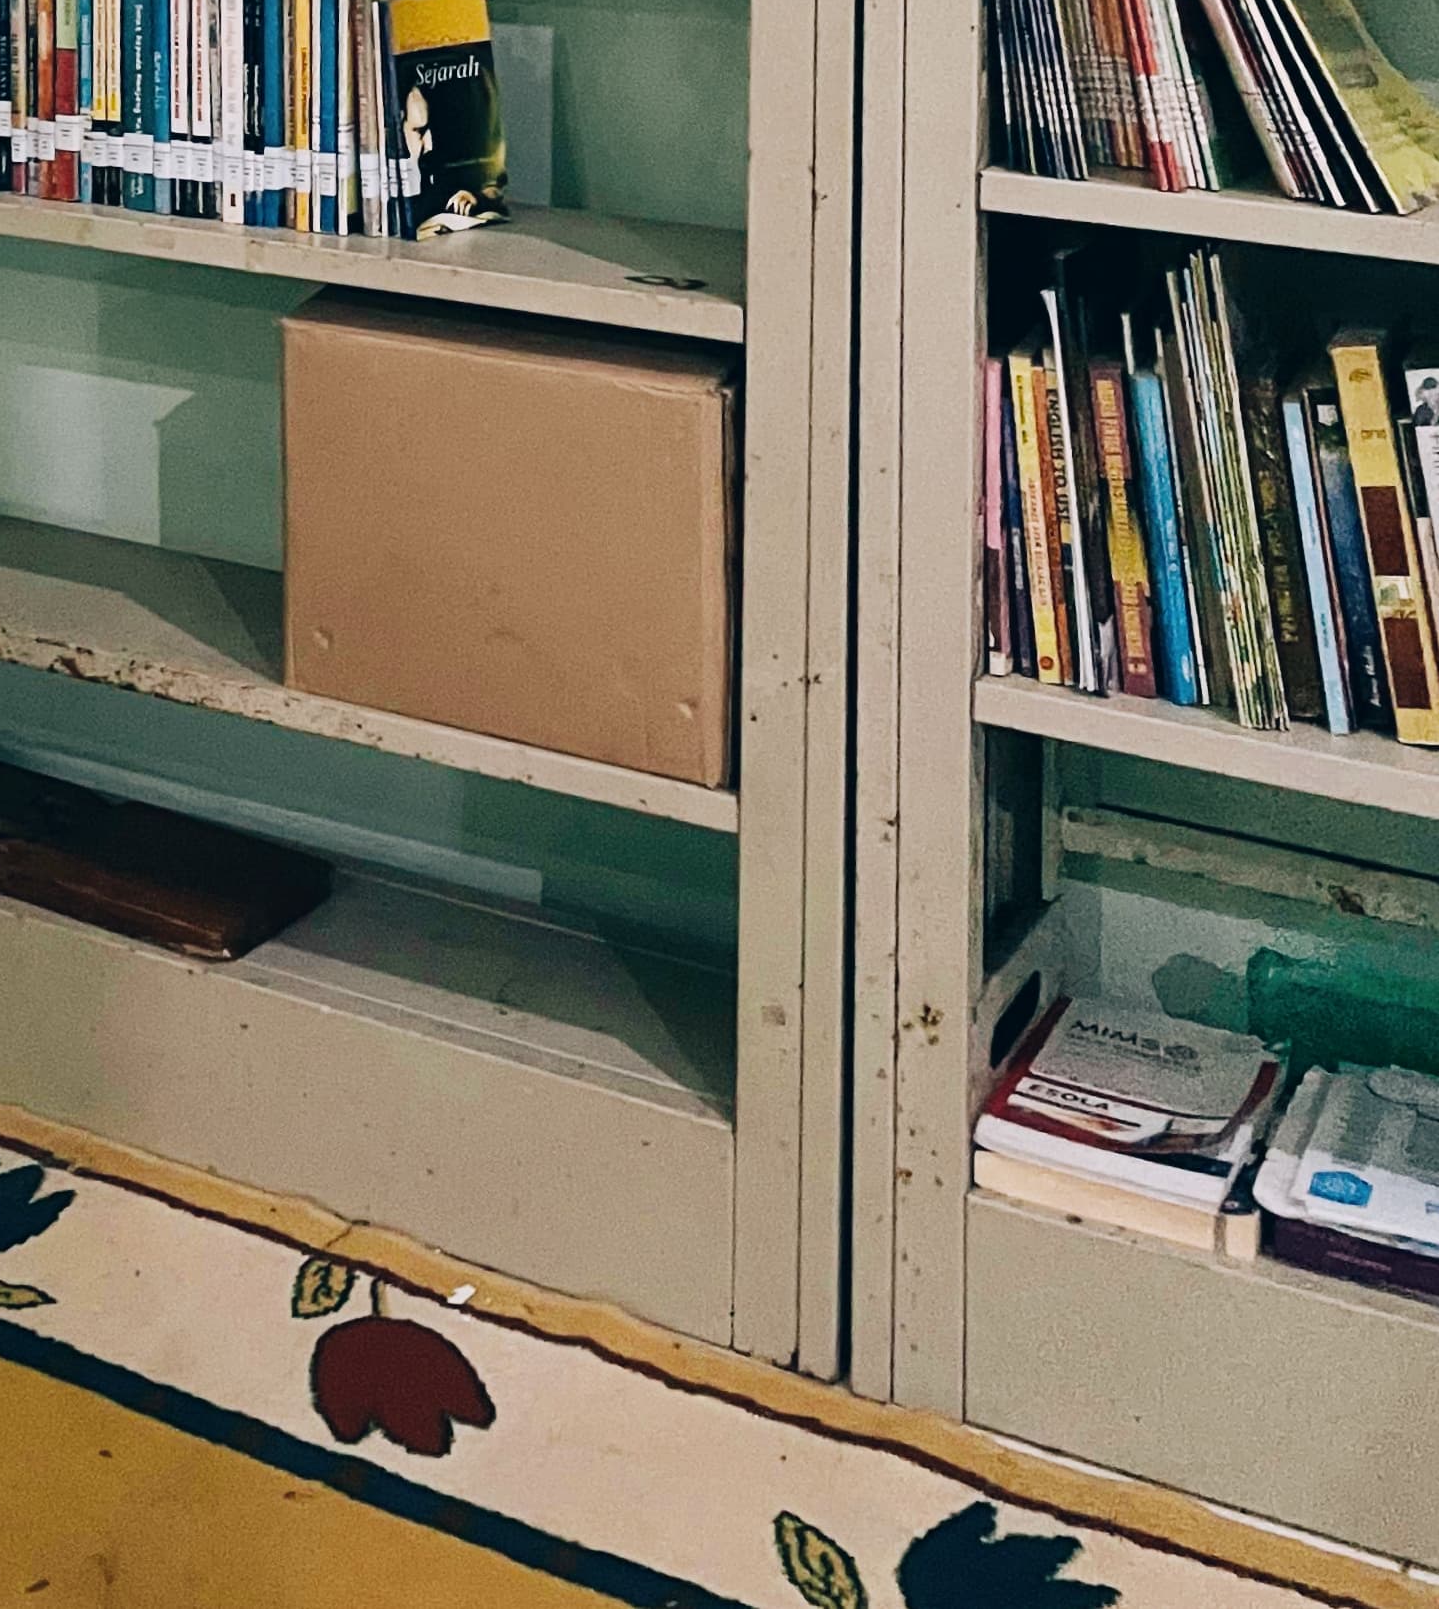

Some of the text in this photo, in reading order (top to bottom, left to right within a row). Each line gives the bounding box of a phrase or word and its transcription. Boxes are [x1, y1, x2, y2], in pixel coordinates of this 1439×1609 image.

[416, 54, 480, 89] Sejarah
[1044, 388, 1064, 460] ENGLISH
[1052, 463, 1067, 488] TO
